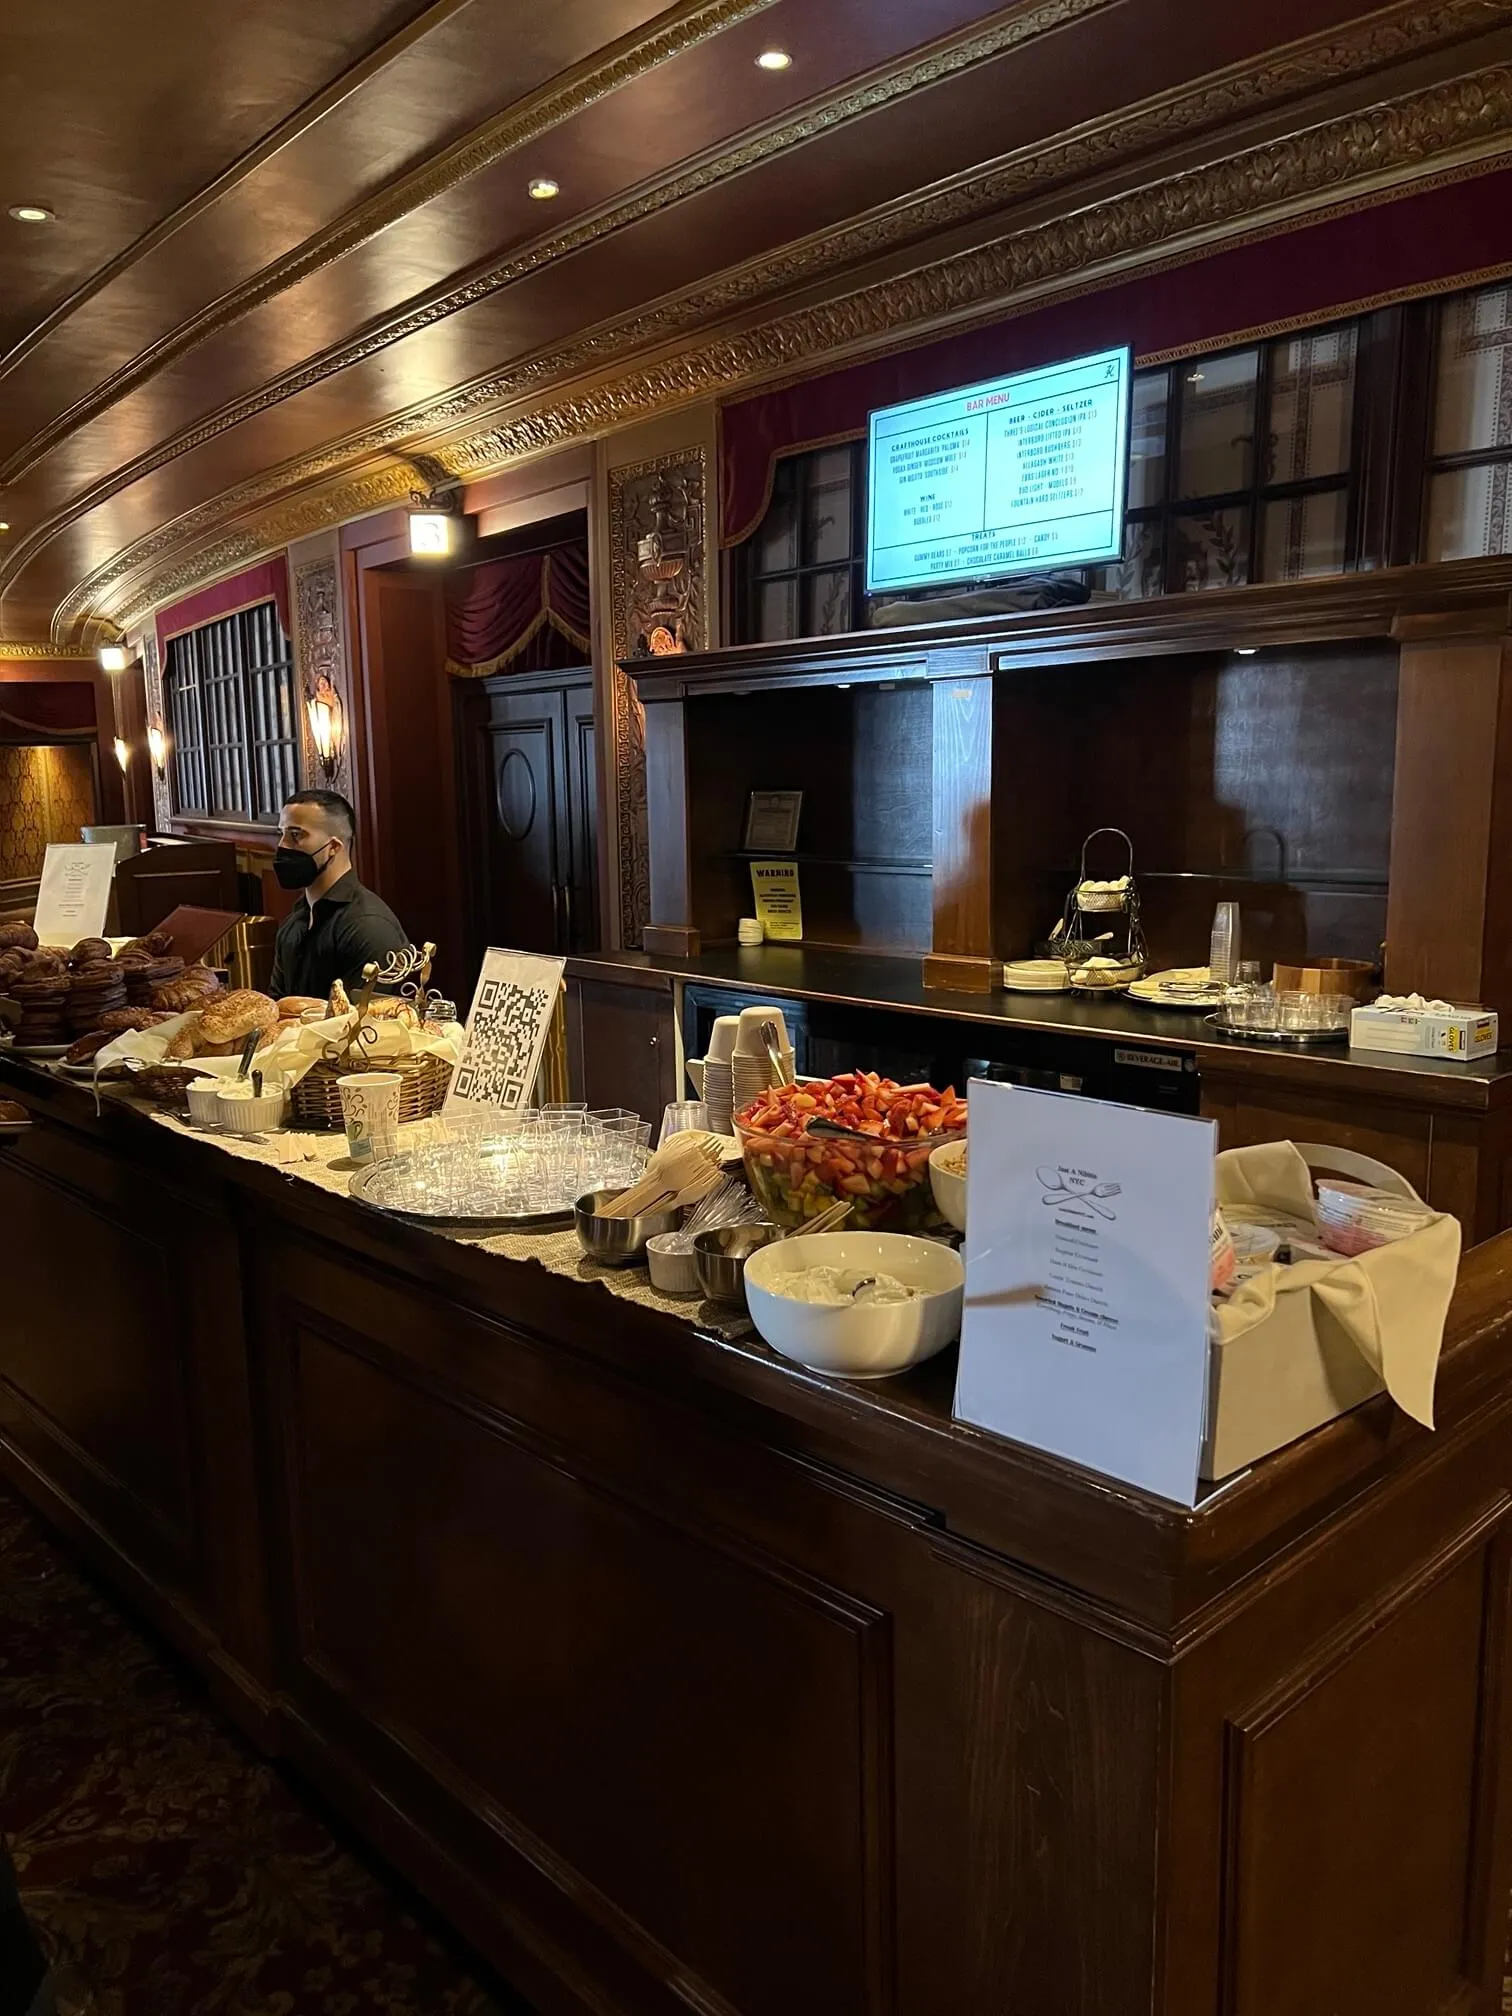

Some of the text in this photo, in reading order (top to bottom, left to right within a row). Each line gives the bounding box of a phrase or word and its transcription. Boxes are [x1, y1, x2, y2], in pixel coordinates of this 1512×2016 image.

[966, 391, 1011, 412] BAR MENU
[1009, 415, 1025, 425] BEER
[1033, 408, 1055, 419] CIDER
[1062, 399, 1093, 412] SELTZER
[891, 428, 969, 452] CRAFTHOUSE COCKTAILS
[920, 494, 936, 503] WINE
[972, 532, 996, 541] TREATS
[756, 869, 795, 878] WARNING
[1069, 1177, 1086, 1186] NYC
